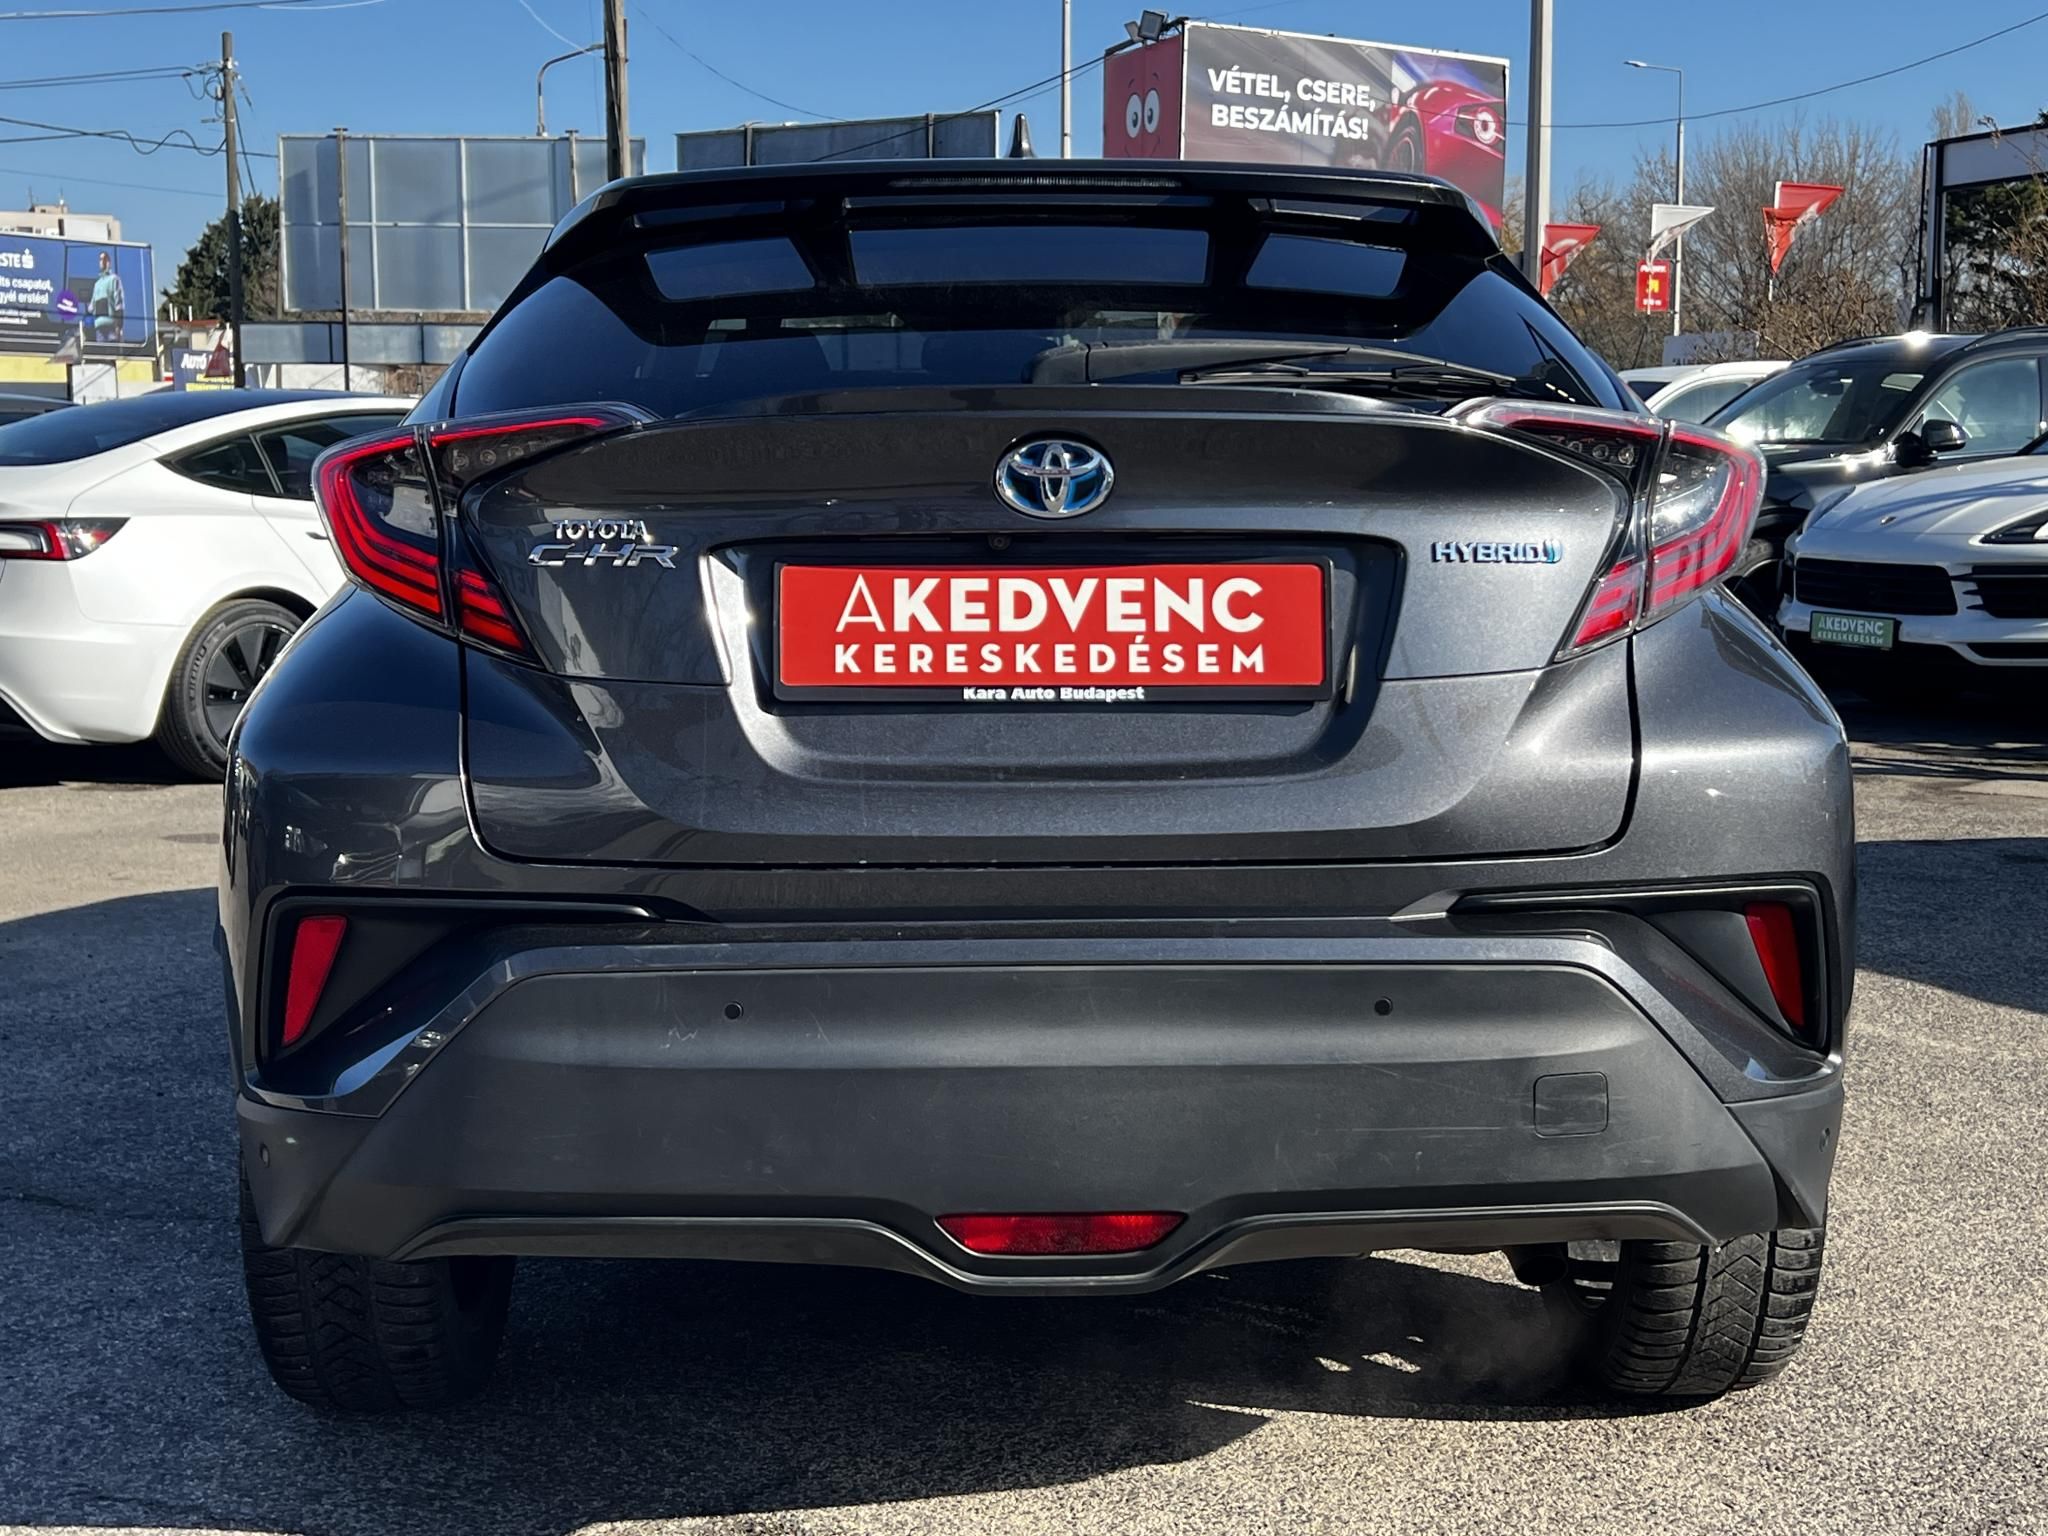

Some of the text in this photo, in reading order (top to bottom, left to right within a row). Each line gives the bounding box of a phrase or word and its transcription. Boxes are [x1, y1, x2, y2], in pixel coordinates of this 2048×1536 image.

[1207, 65, 1376, 112] VÉTEL, CSERE,
[1211, 104, 1369, 140] BESZÁMÍTÁS!
[552, 519, 653, 542] TOYOTA
[528, 543, 678, 568] C-HR
[1431, 541, 1547, 564] HYBRID
[834, 634, 1265, 674] KERESKEDÉSEM
[963, 686, 1145, 703] Kara Auto Budapest
